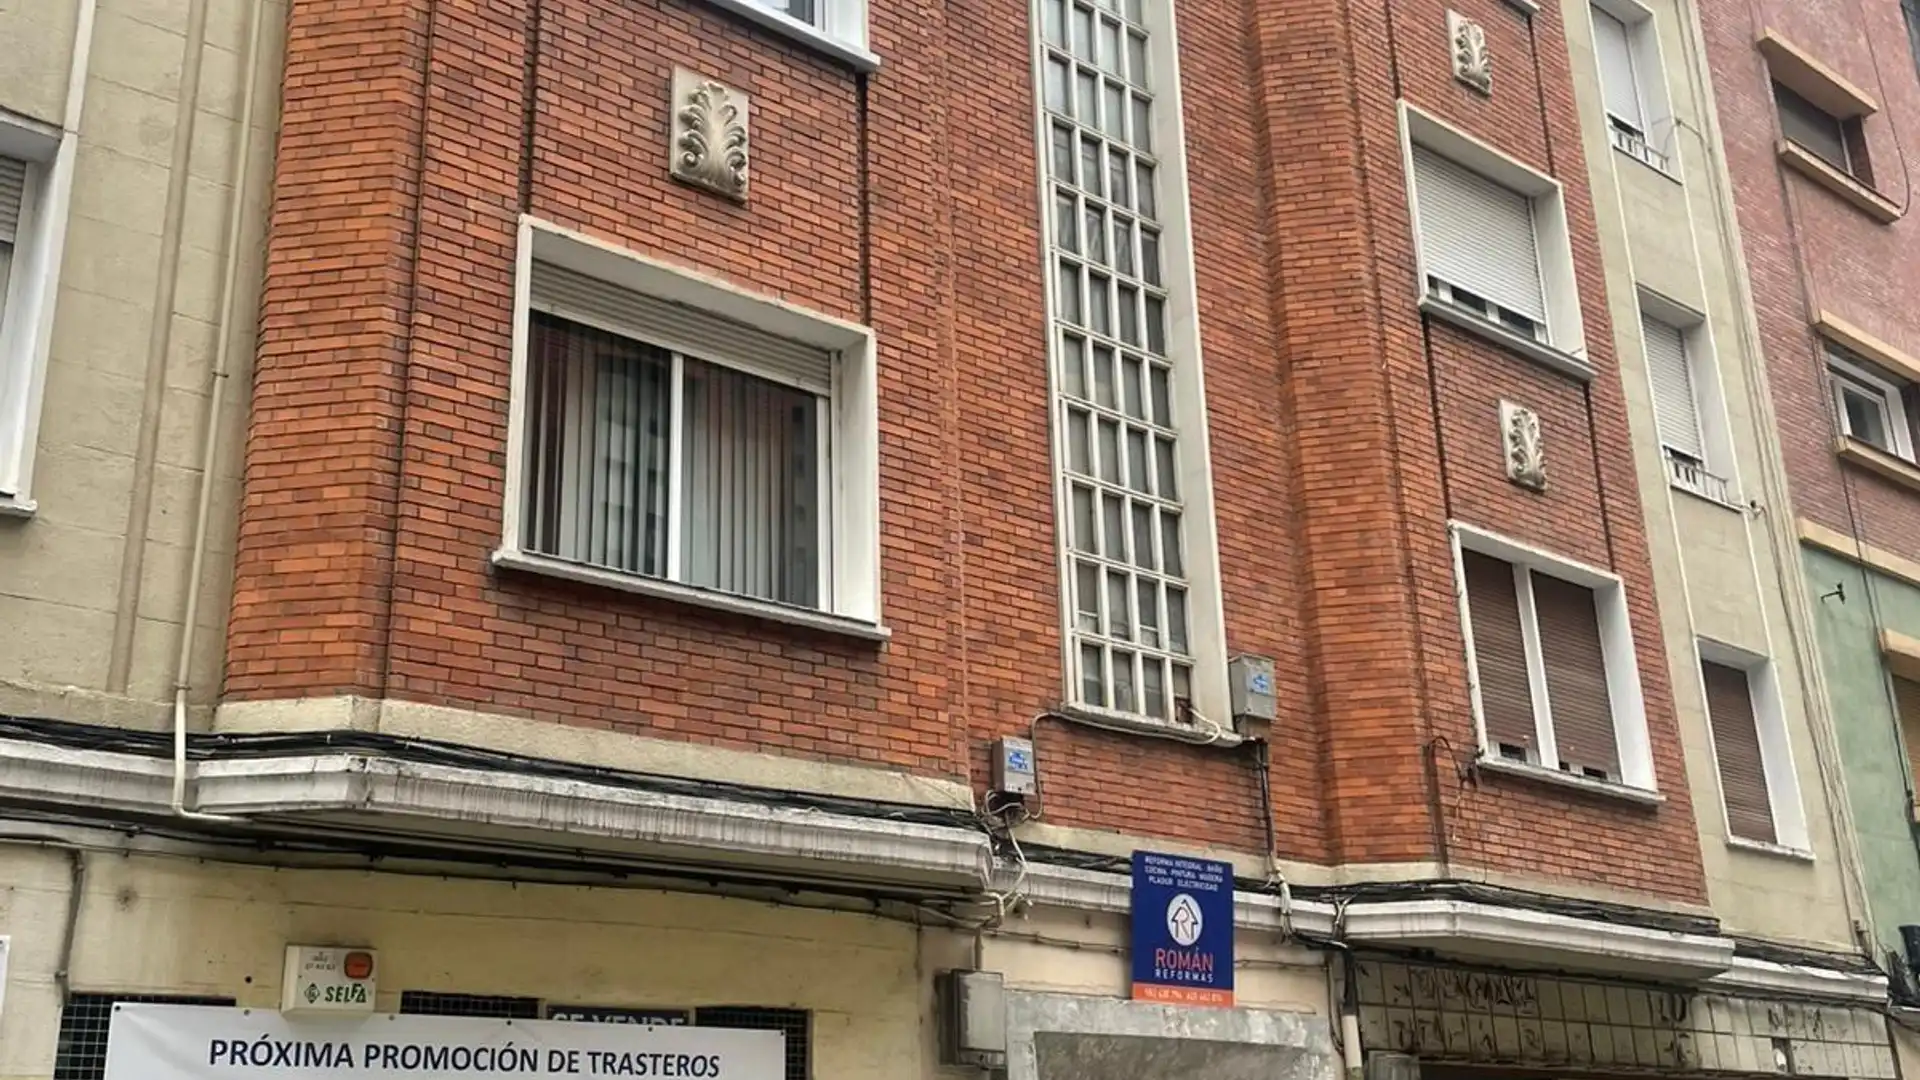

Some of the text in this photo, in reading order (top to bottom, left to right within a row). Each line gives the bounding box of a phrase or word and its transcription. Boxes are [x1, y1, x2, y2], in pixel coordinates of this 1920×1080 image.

[1155, 946, 1213, 972] ROMÁN
[1155, 968, 1214, 983] REFORMAS
[325, 983, 367, 1003] SELFA
[209, 1034, 720, 1078] PRÓXIMA PROMOCIÓN DE TRASTEROS
